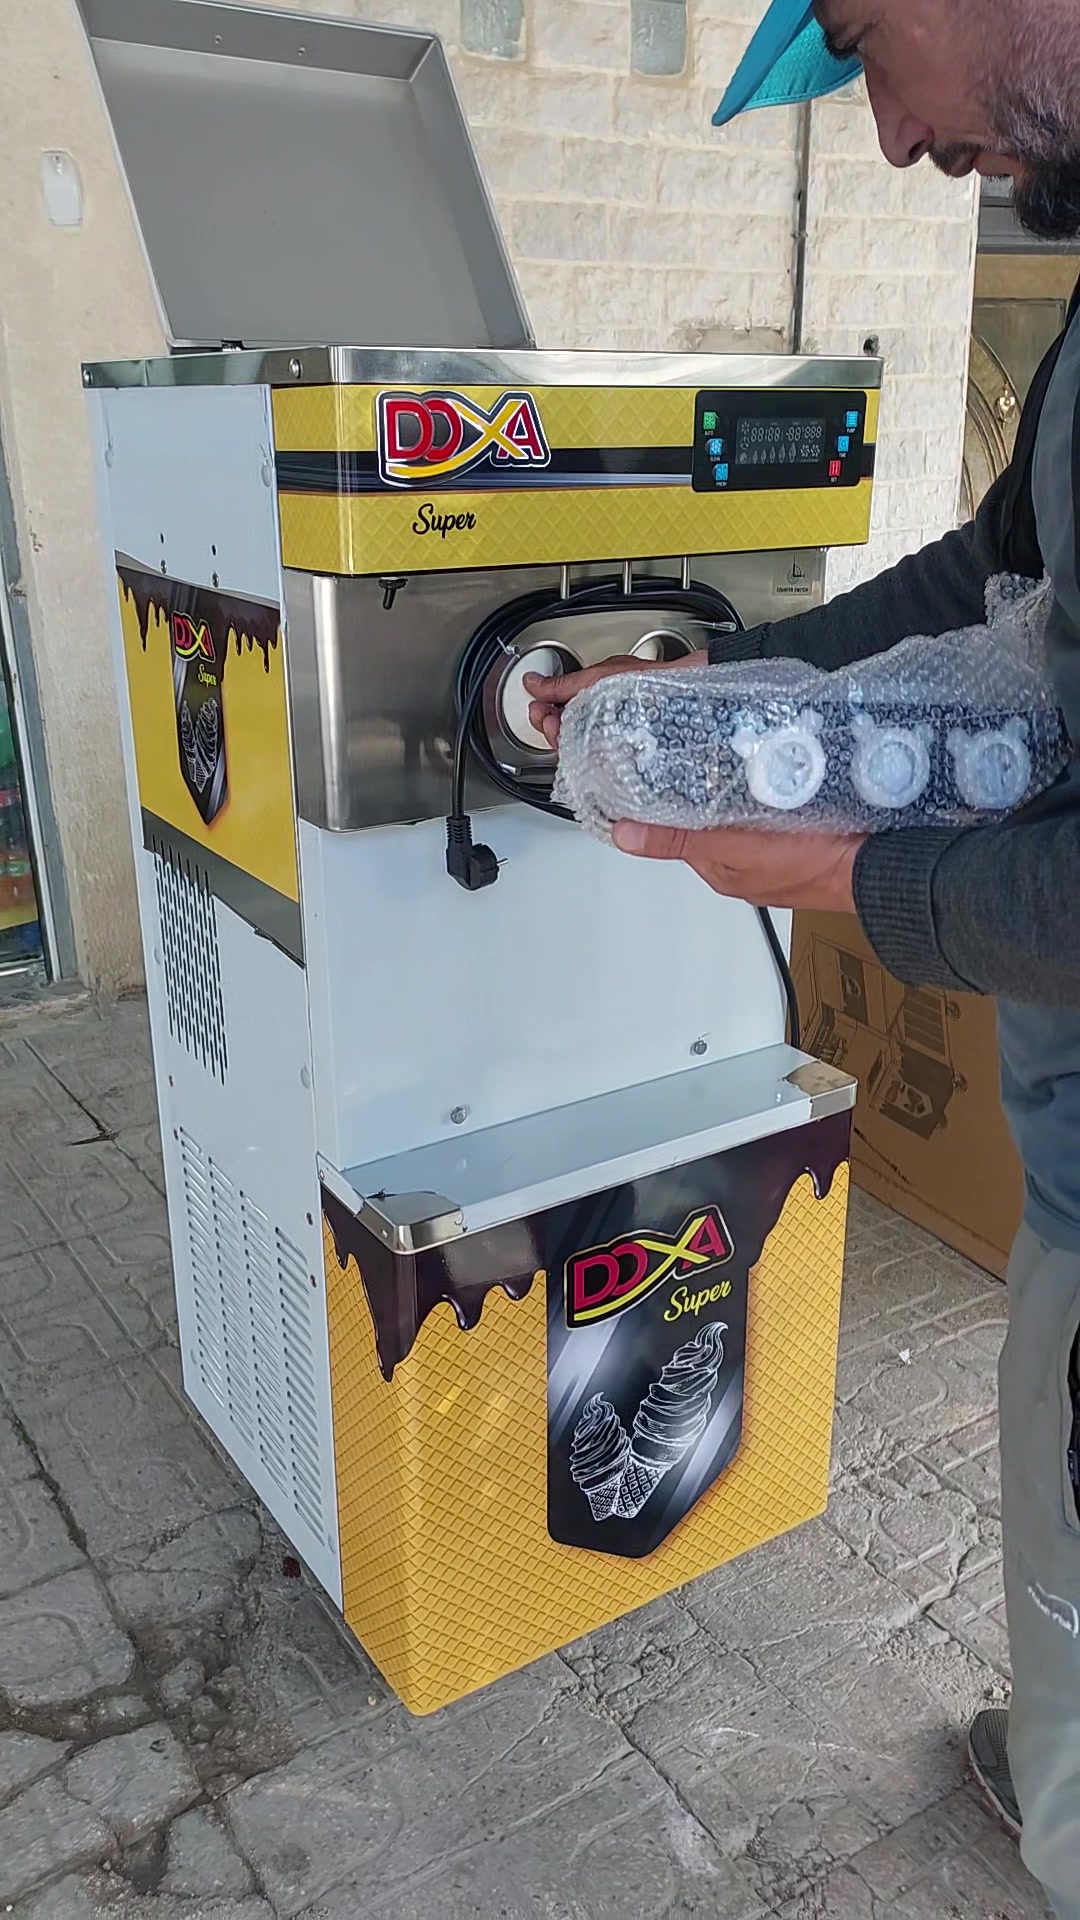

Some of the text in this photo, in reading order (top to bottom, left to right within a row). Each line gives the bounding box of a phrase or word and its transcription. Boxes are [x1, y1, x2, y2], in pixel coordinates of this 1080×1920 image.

[385, 398, 545, 478] DOXA
[412, 503, 477, 539] Super
[198, 663, 217, 687] Super
[573, 1214, 727, 1321] DOXA
[663, 1280, 732, 1322] Super
